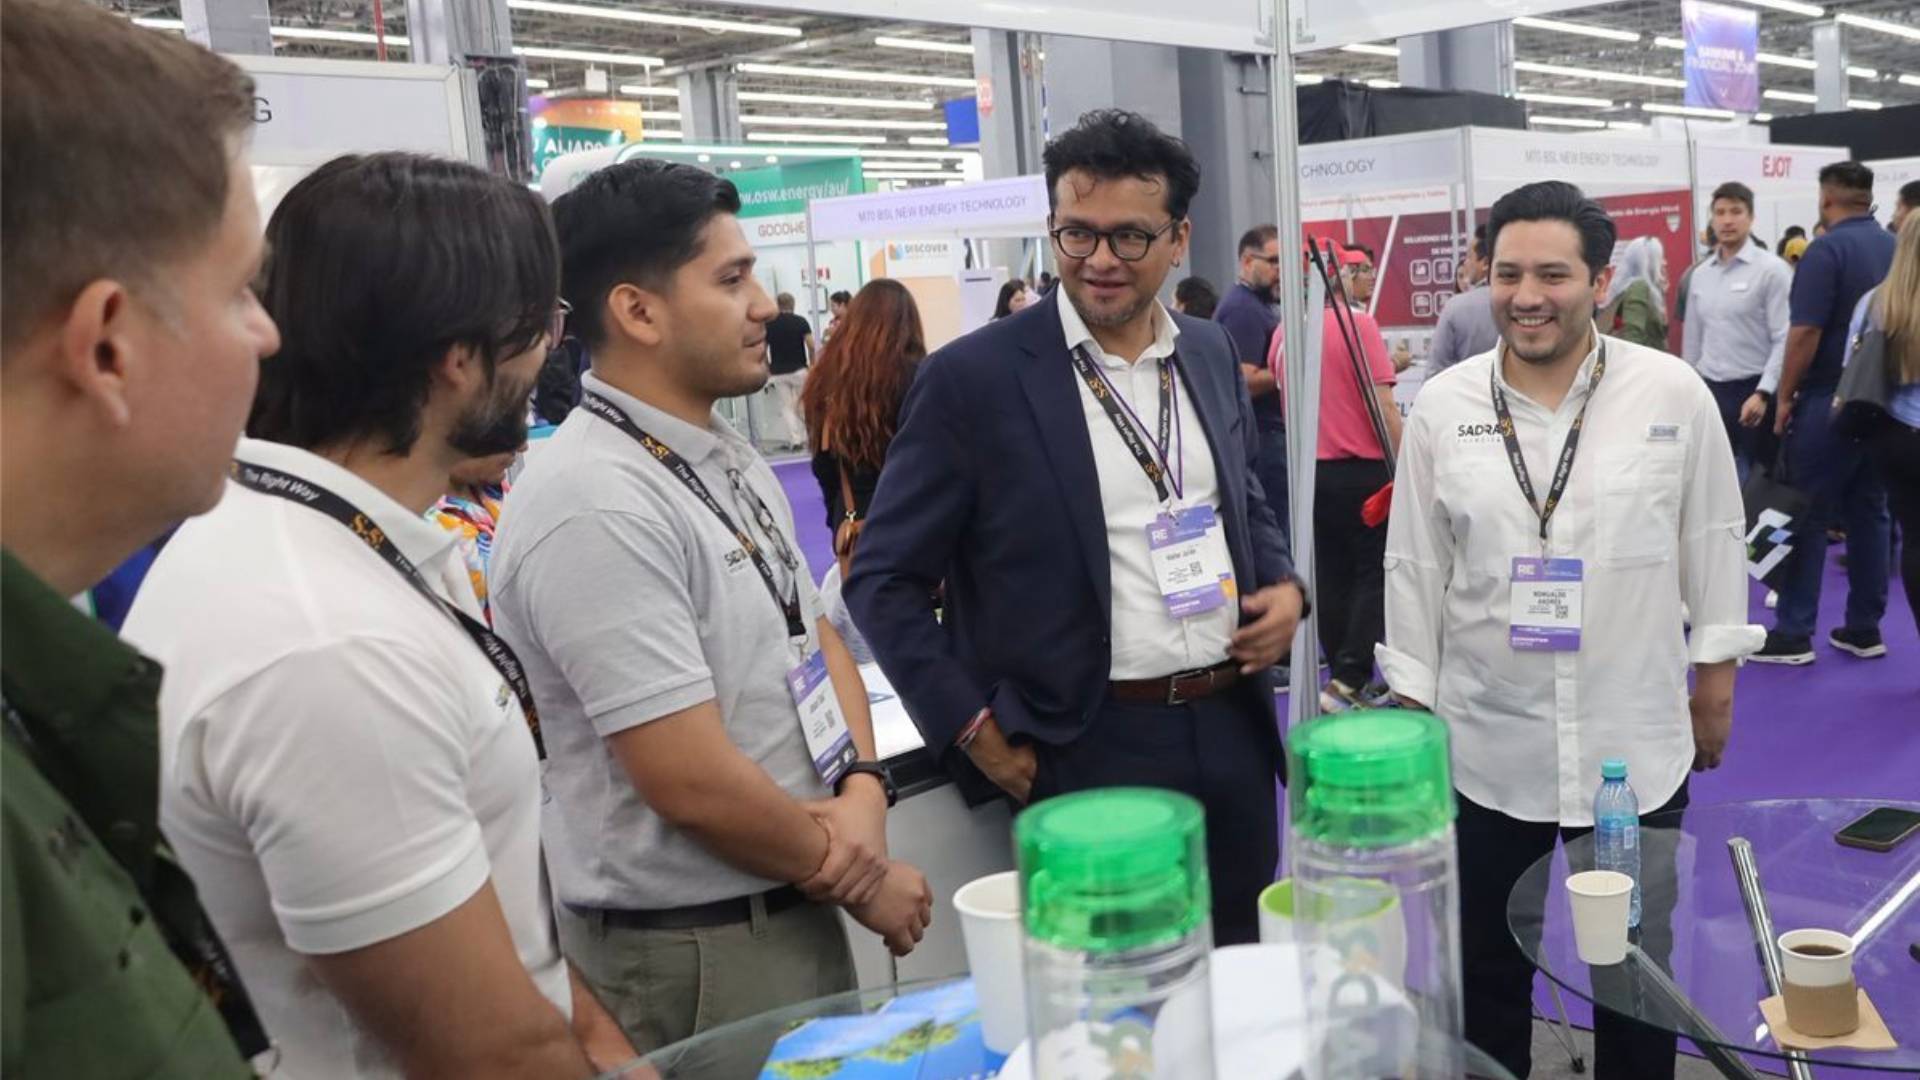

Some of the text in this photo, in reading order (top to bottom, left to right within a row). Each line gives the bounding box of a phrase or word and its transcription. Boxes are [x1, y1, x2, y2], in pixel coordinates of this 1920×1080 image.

[1301, 159, 1376, 178] CHNOLOGY
[1559, 151, 1577, 165] NEW
[1579, 151, 1610, 166] ENERGY
[1612, 153, 1660, 167] TECHNOLOGY
[1762, 155, 1793, 177] EJOT
[894, 206, 917, 219] NEW
[919, 202, 958, 217] ENERGY
[960, 196, 1027, 213] TECHNOLOGY
[904, 243, 949, 254] DISCOVER
[289, 480, 321, 502] Way
